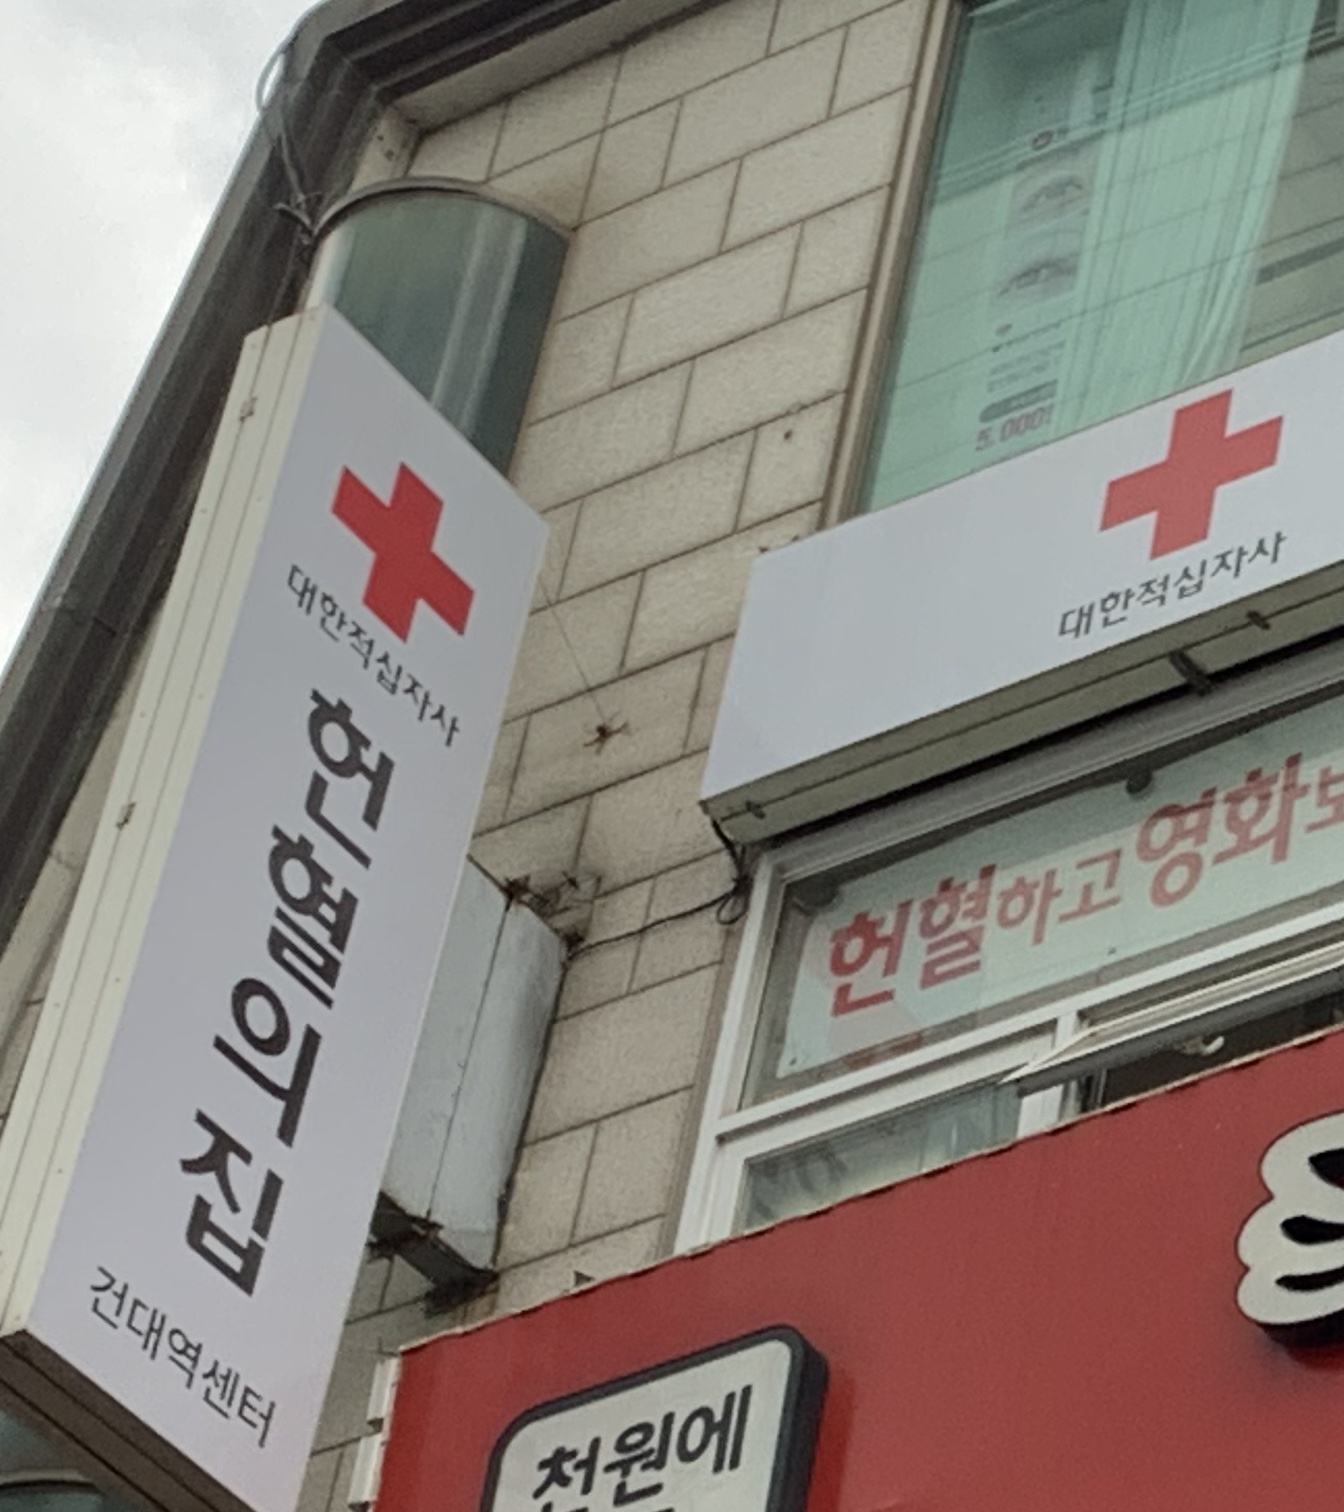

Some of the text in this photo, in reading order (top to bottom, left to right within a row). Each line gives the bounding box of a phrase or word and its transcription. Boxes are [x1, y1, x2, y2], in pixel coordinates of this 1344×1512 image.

[287, 562, 462, 749] 대한적십자사
[1058, 531, 1287, 640] 대한적십자사
[180, 687, 395, 1298] 헌혈의집
[88, 1266, 280, 1449] 건대역센터
